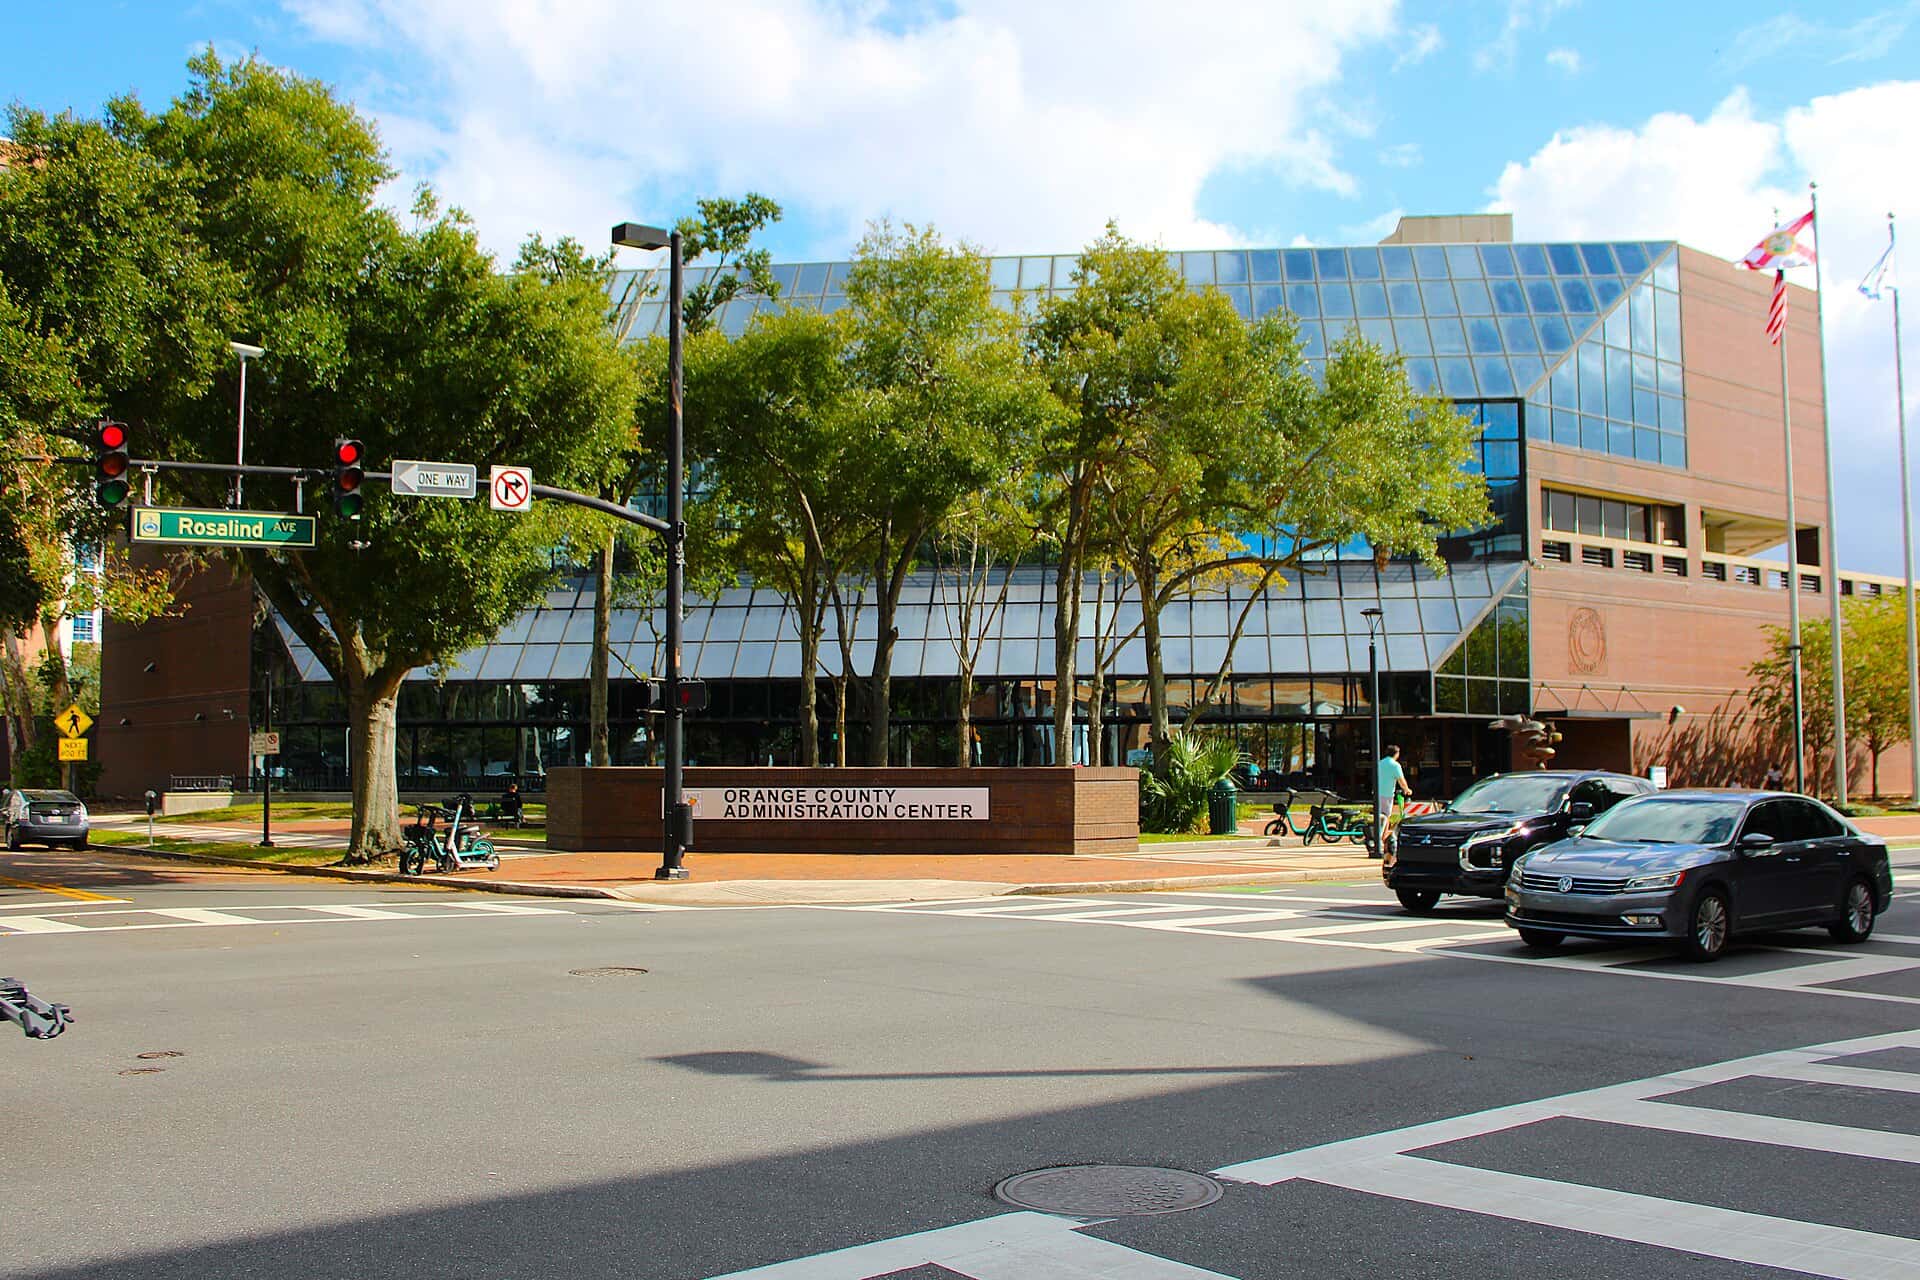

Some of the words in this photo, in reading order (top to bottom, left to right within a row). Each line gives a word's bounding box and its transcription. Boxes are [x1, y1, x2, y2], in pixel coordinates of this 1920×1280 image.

[418, 472, 439, 485] ONE
[446, 474, 467, 487] WAY
[178, 517, 264, 539] Rosalind
[272, 522, 297, 533] AVE
[724, 789, 807, 803] ORANGE
[815, 789, 897, 803] COUNTY
[724, 805, 892, 818] ADMINISTRATION
[894, 805, 974, 818] CENTER
